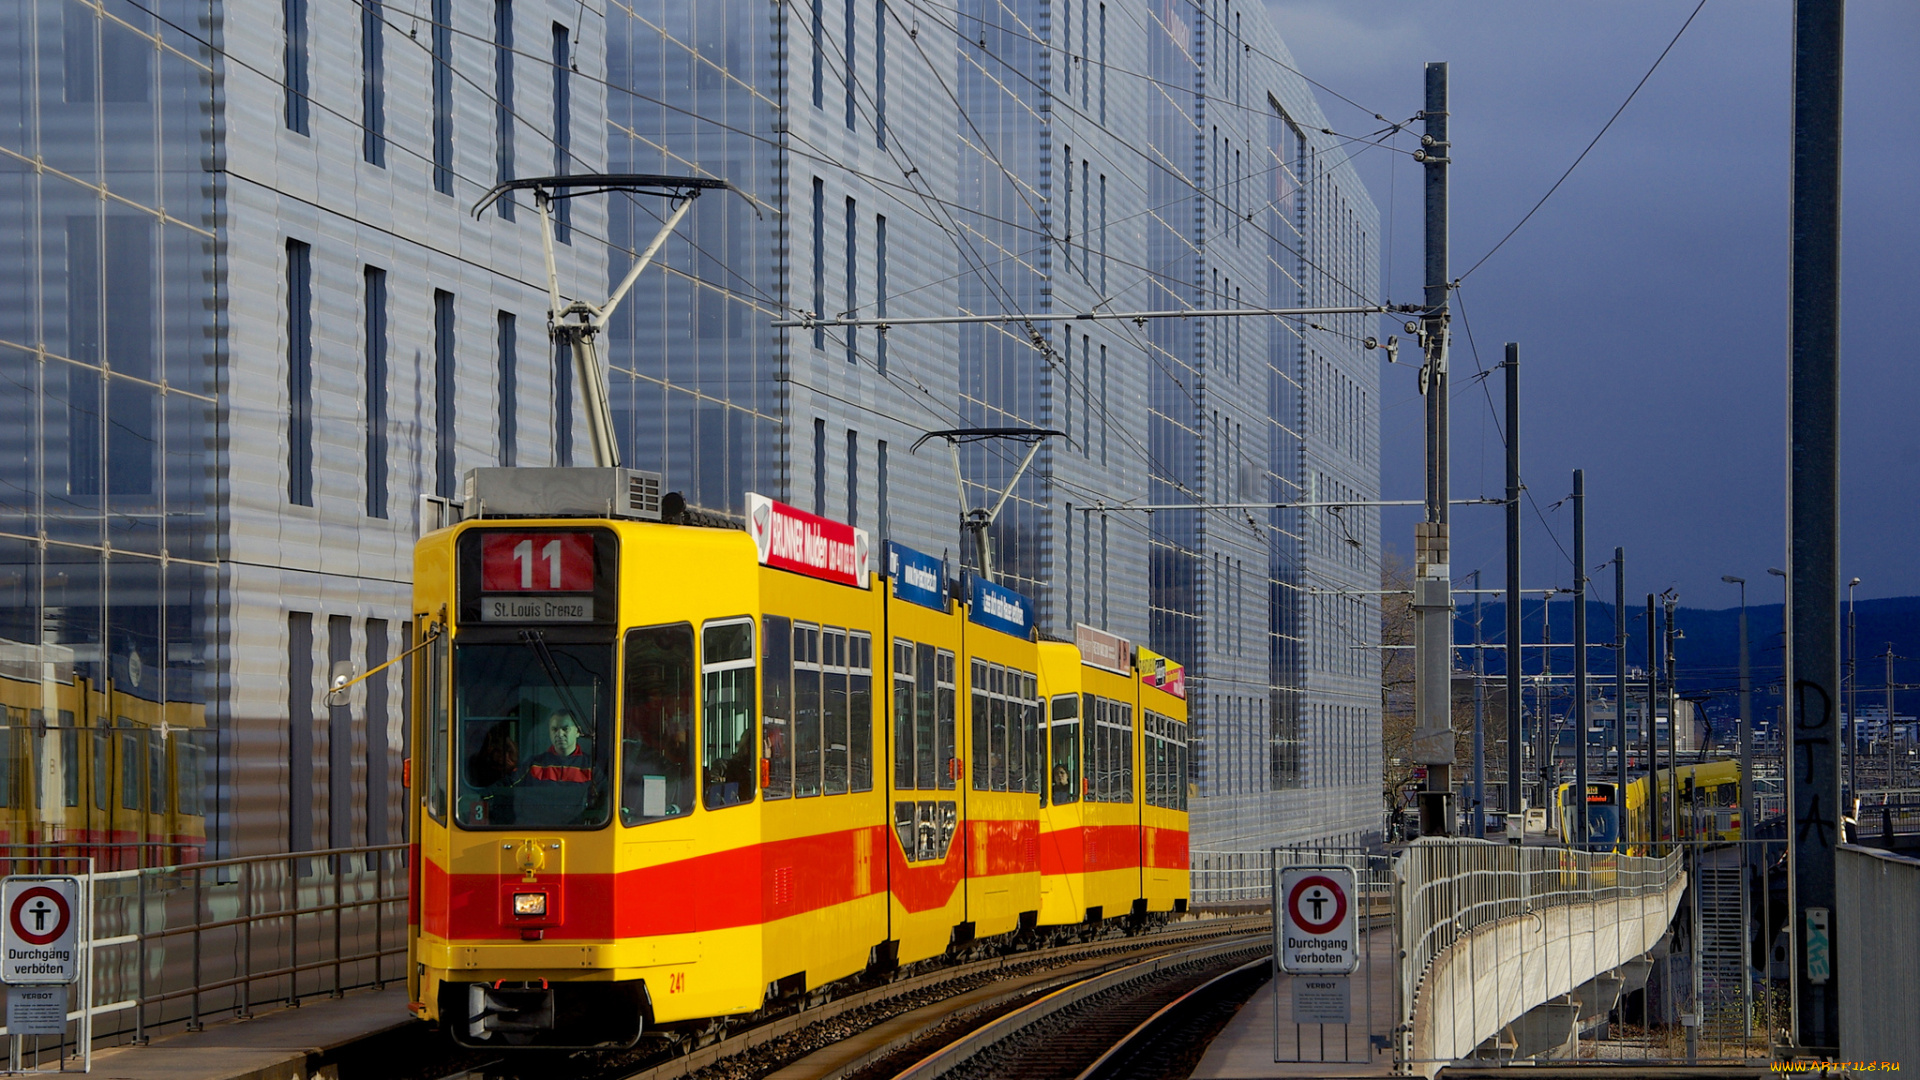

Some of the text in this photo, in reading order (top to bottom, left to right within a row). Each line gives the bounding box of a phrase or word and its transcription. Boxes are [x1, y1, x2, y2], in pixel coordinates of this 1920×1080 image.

[513, 540, 561, 588] 11
[544, 602, 583, 617] Grenze
[475, 804, 483, 821] 3
[1288, 937, 1348, 950] Durchgang
[1294, 952, 1342, 963] verboten
[670, 972, 685, 993] 241
